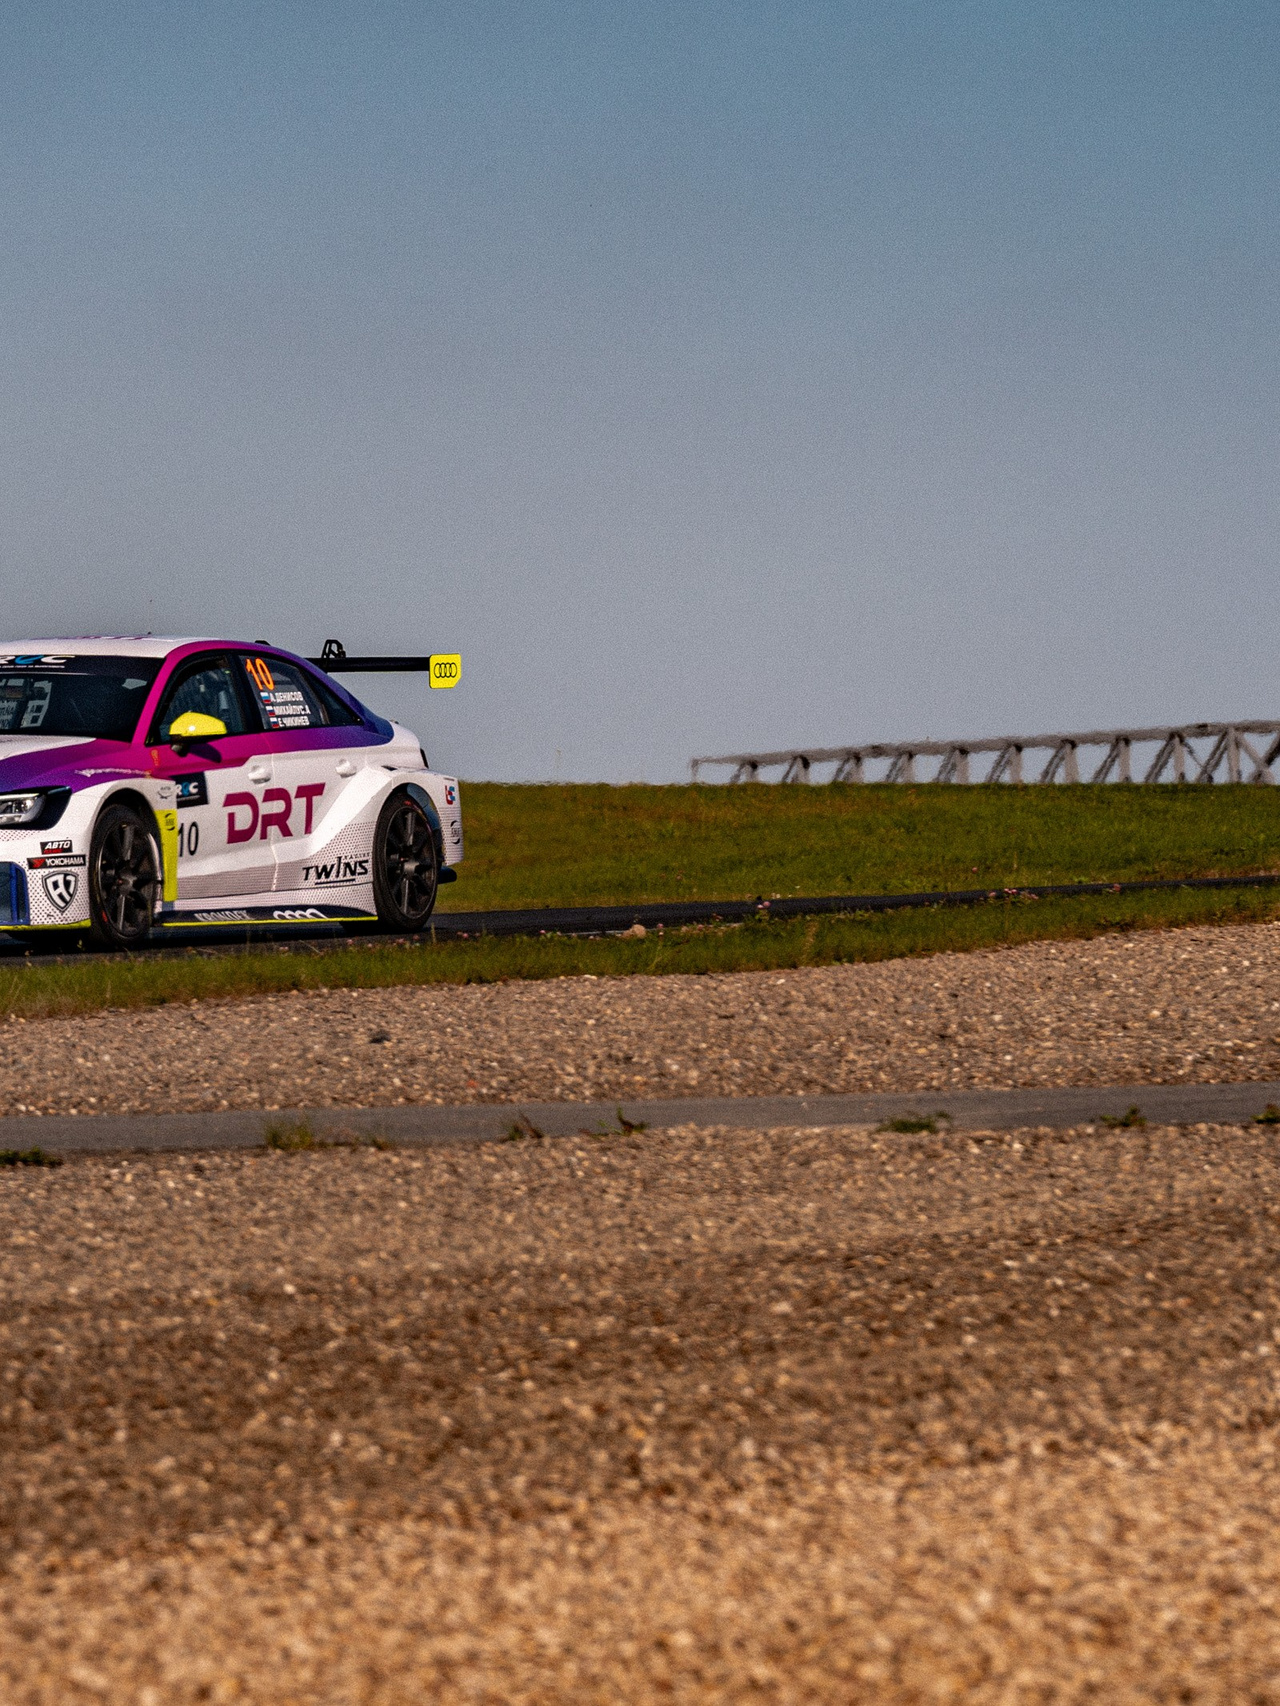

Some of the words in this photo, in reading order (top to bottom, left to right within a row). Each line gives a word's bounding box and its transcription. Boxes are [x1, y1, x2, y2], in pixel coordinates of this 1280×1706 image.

[245, 657, 275, 691] 10
[222, 782, 325, 844] DRT
[178, 821, 199, 857] 10
[45, 856, 84, 866] YOKOHAMA
[302, 856, 369, 881] TWINS
